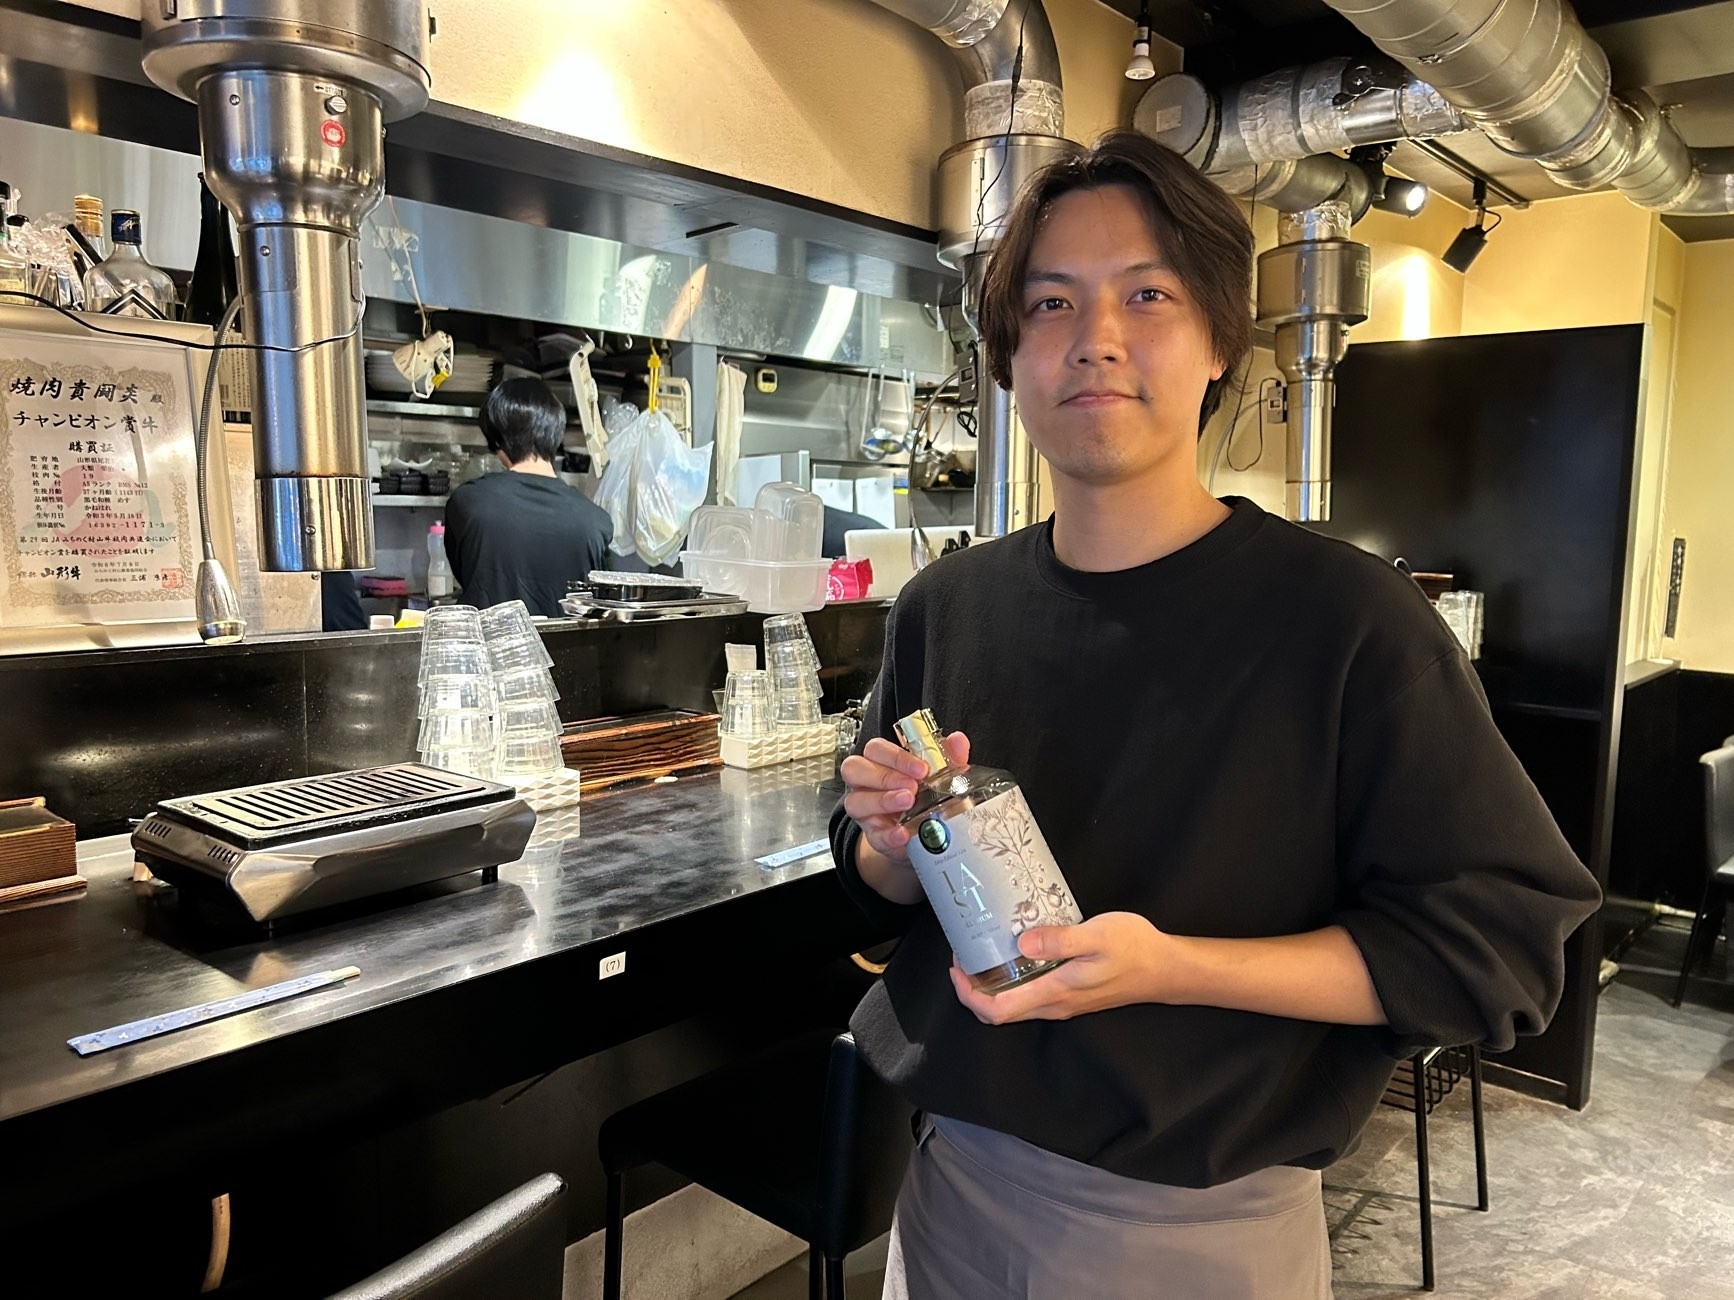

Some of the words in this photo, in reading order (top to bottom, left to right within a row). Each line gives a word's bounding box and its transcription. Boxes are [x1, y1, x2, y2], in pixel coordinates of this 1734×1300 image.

[13, 411, 158, 434] チャンピオン賞牛
[68, 441, 115, 454] 購買証
[40, 565, 82, 581] 山形牛
